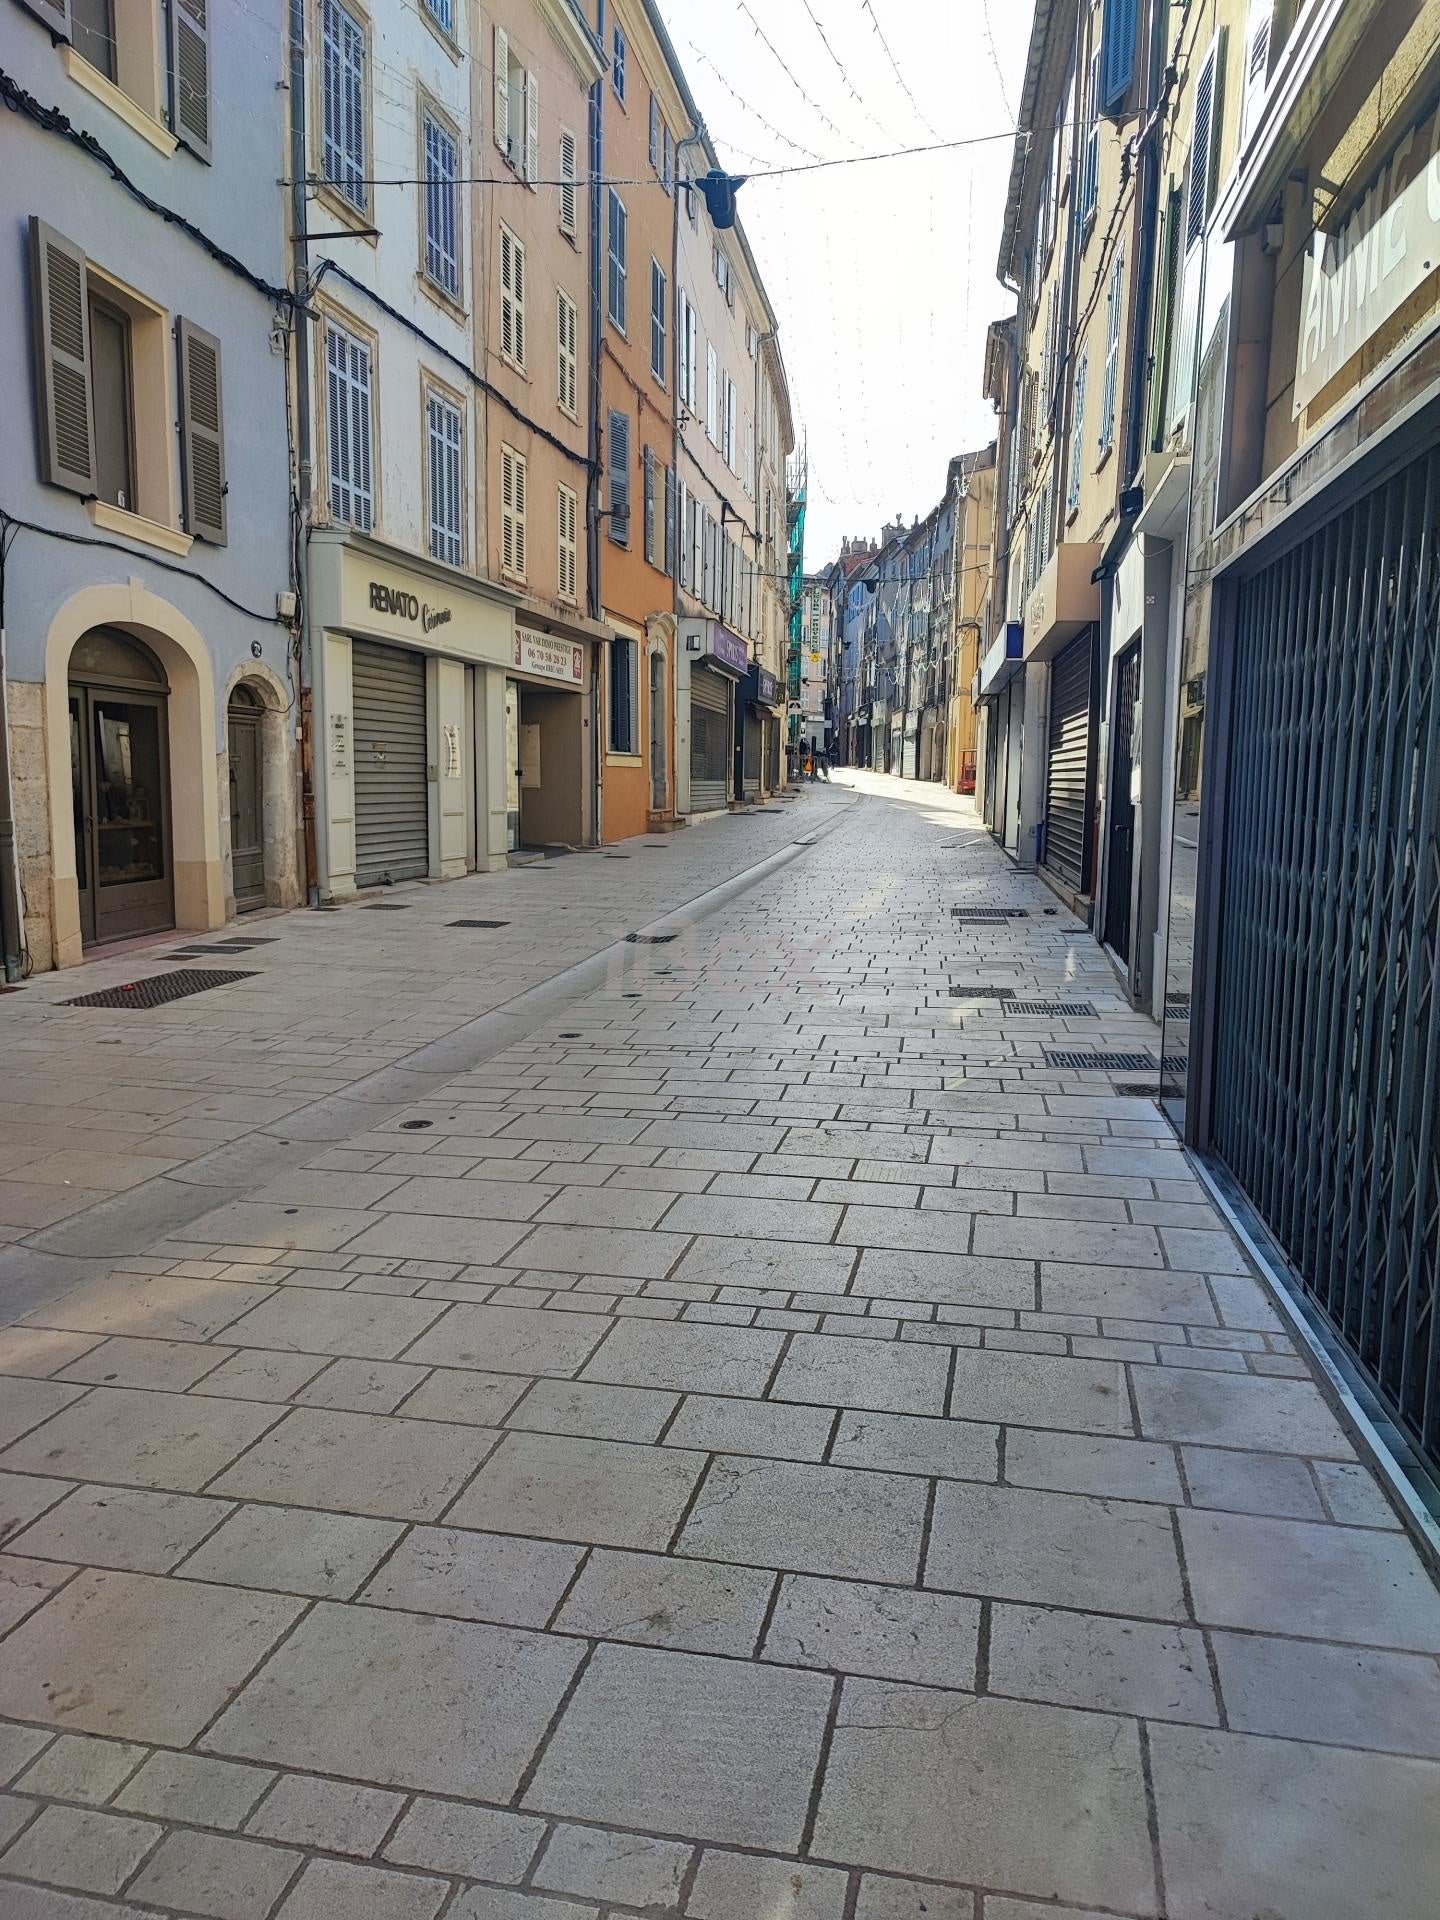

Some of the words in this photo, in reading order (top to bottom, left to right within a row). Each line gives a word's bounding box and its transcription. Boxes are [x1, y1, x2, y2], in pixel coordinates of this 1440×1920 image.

[1301, 125, 1416, 376] ANNIE
[369, 582, 419, 621] RENATO
[527, 647, 536, 659] 06
[536, 649, 544, 661] 70
